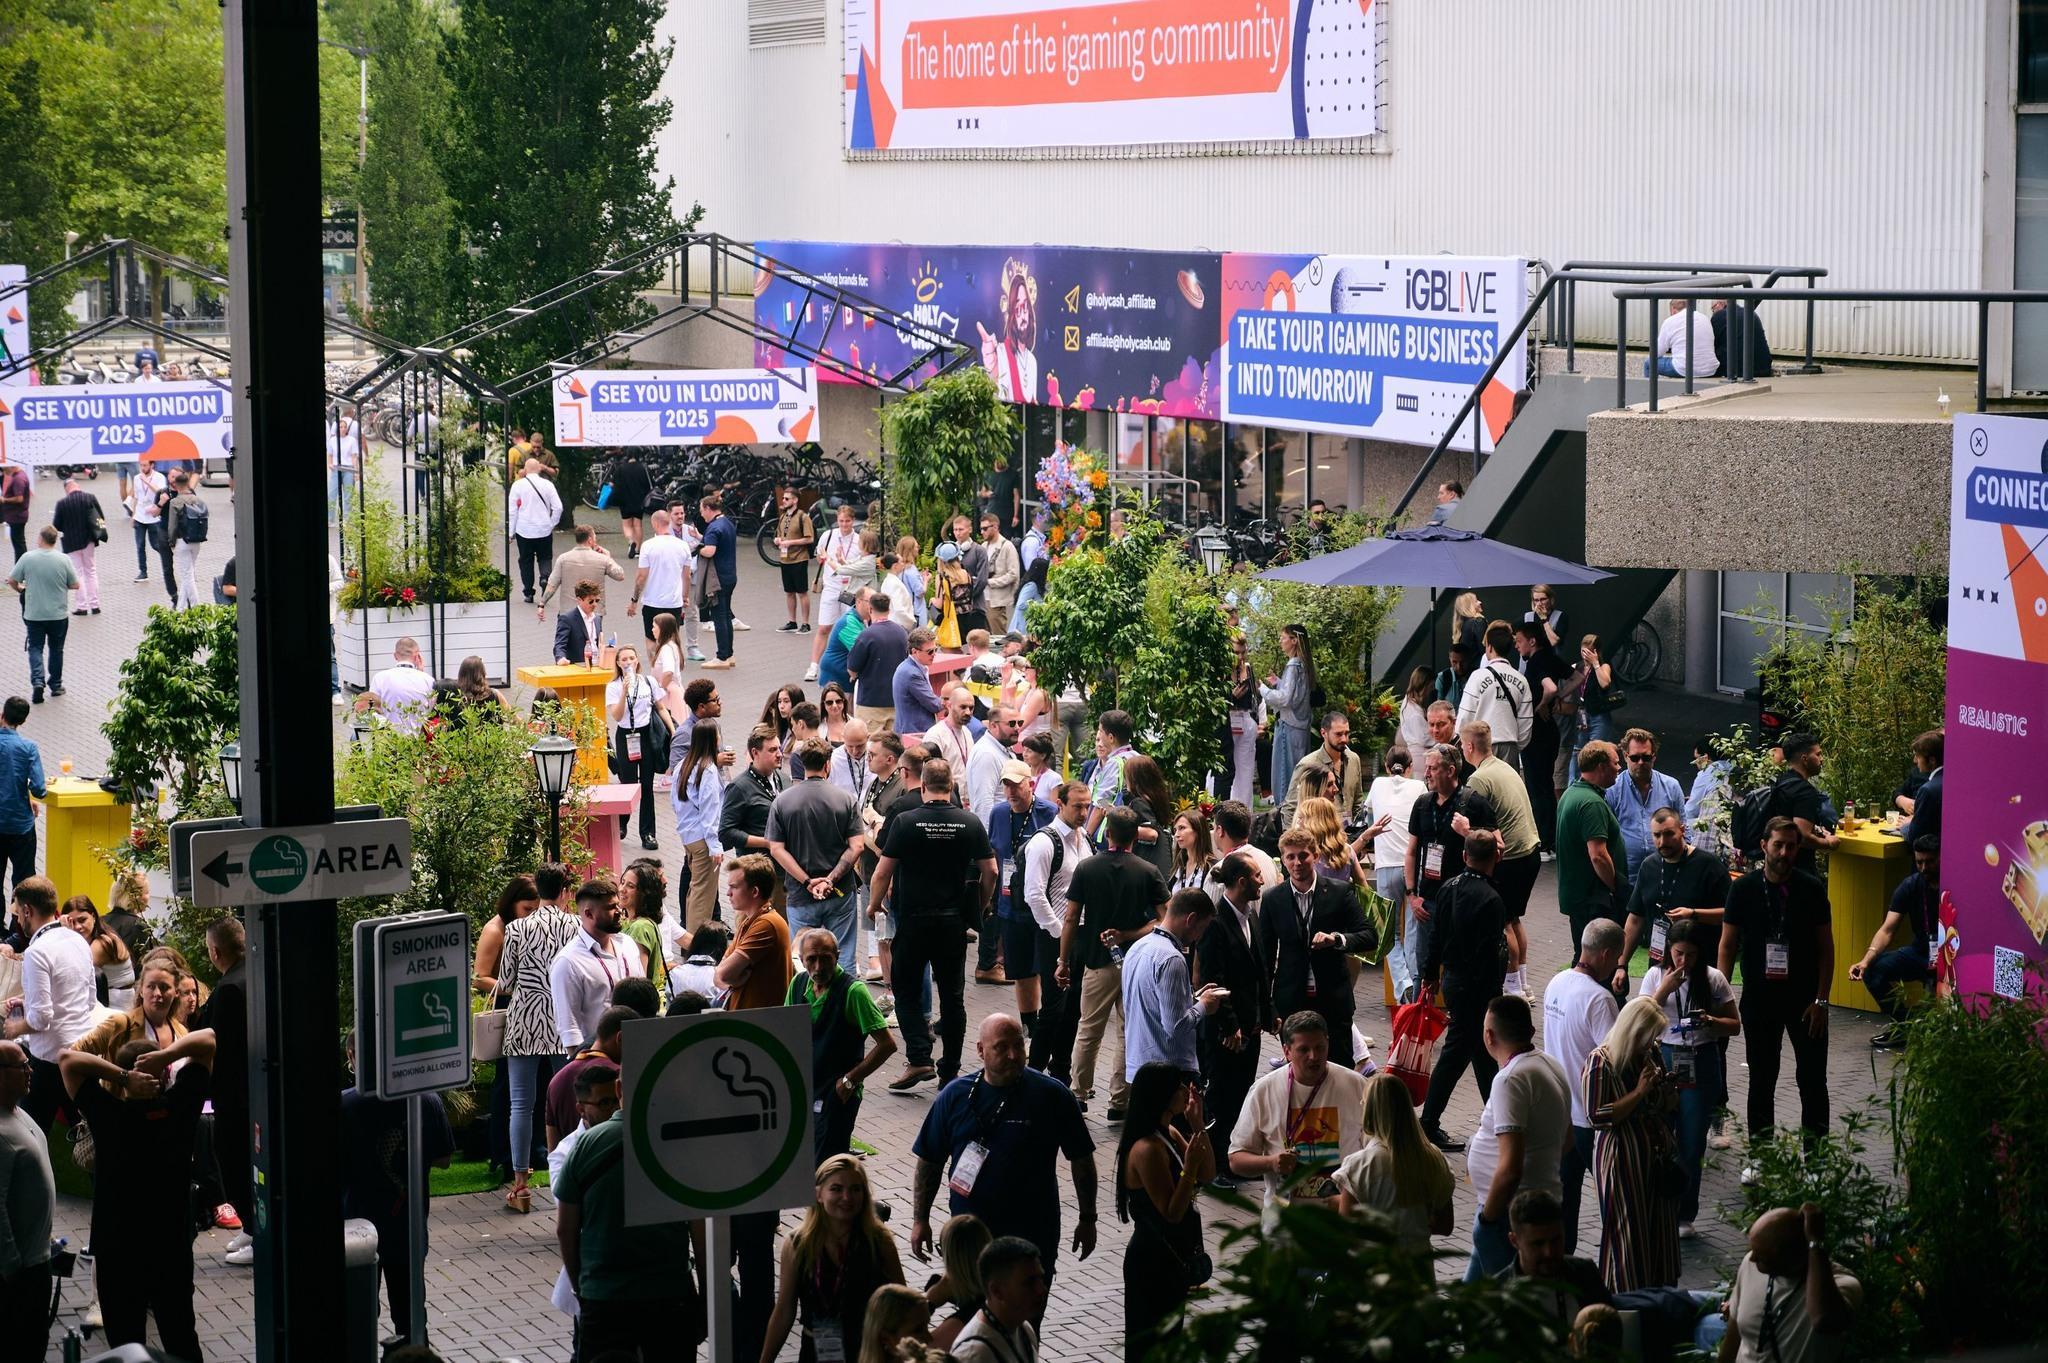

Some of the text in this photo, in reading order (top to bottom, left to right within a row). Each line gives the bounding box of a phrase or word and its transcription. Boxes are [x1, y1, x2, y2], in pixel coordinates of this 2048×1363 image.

[906, 3, 1285, 85] The home of the igaming community
[838, 273, 858, 286] brands
[858, 274, 869, 287] for:
[1086, 292, 1156, 310] @holycash_affiliate
[913, 303, 940, 326] HOLY
[1086, 333, 1171, 352] affiliate@holycash.club
[1237, 316, 1495, 367] TAKE YOUR IGAMING BUSINESS
[598, 381, 774, 404] SEE YOU IN LONDON
[1237, 362, 1374, 405] INTO TOMORROW
[22, 394, 217, 421] SEE YOU IN LONDON
[665, 408, 709, 428] 2025
[97, 423, 146, 445] 2025
[1975, 473, 2048, 512] CONNEC
[1479, 676, 1493, 695] LOS
[1959, 704, 2028, 737] REALISTIC
[313, 842, 404, 875] AREA
[392, 932, 460, 956] SMOKING
[406, 956, 447, 976] AREA
[392, 1059, 462, 1078] SMOKING ALLOWED
